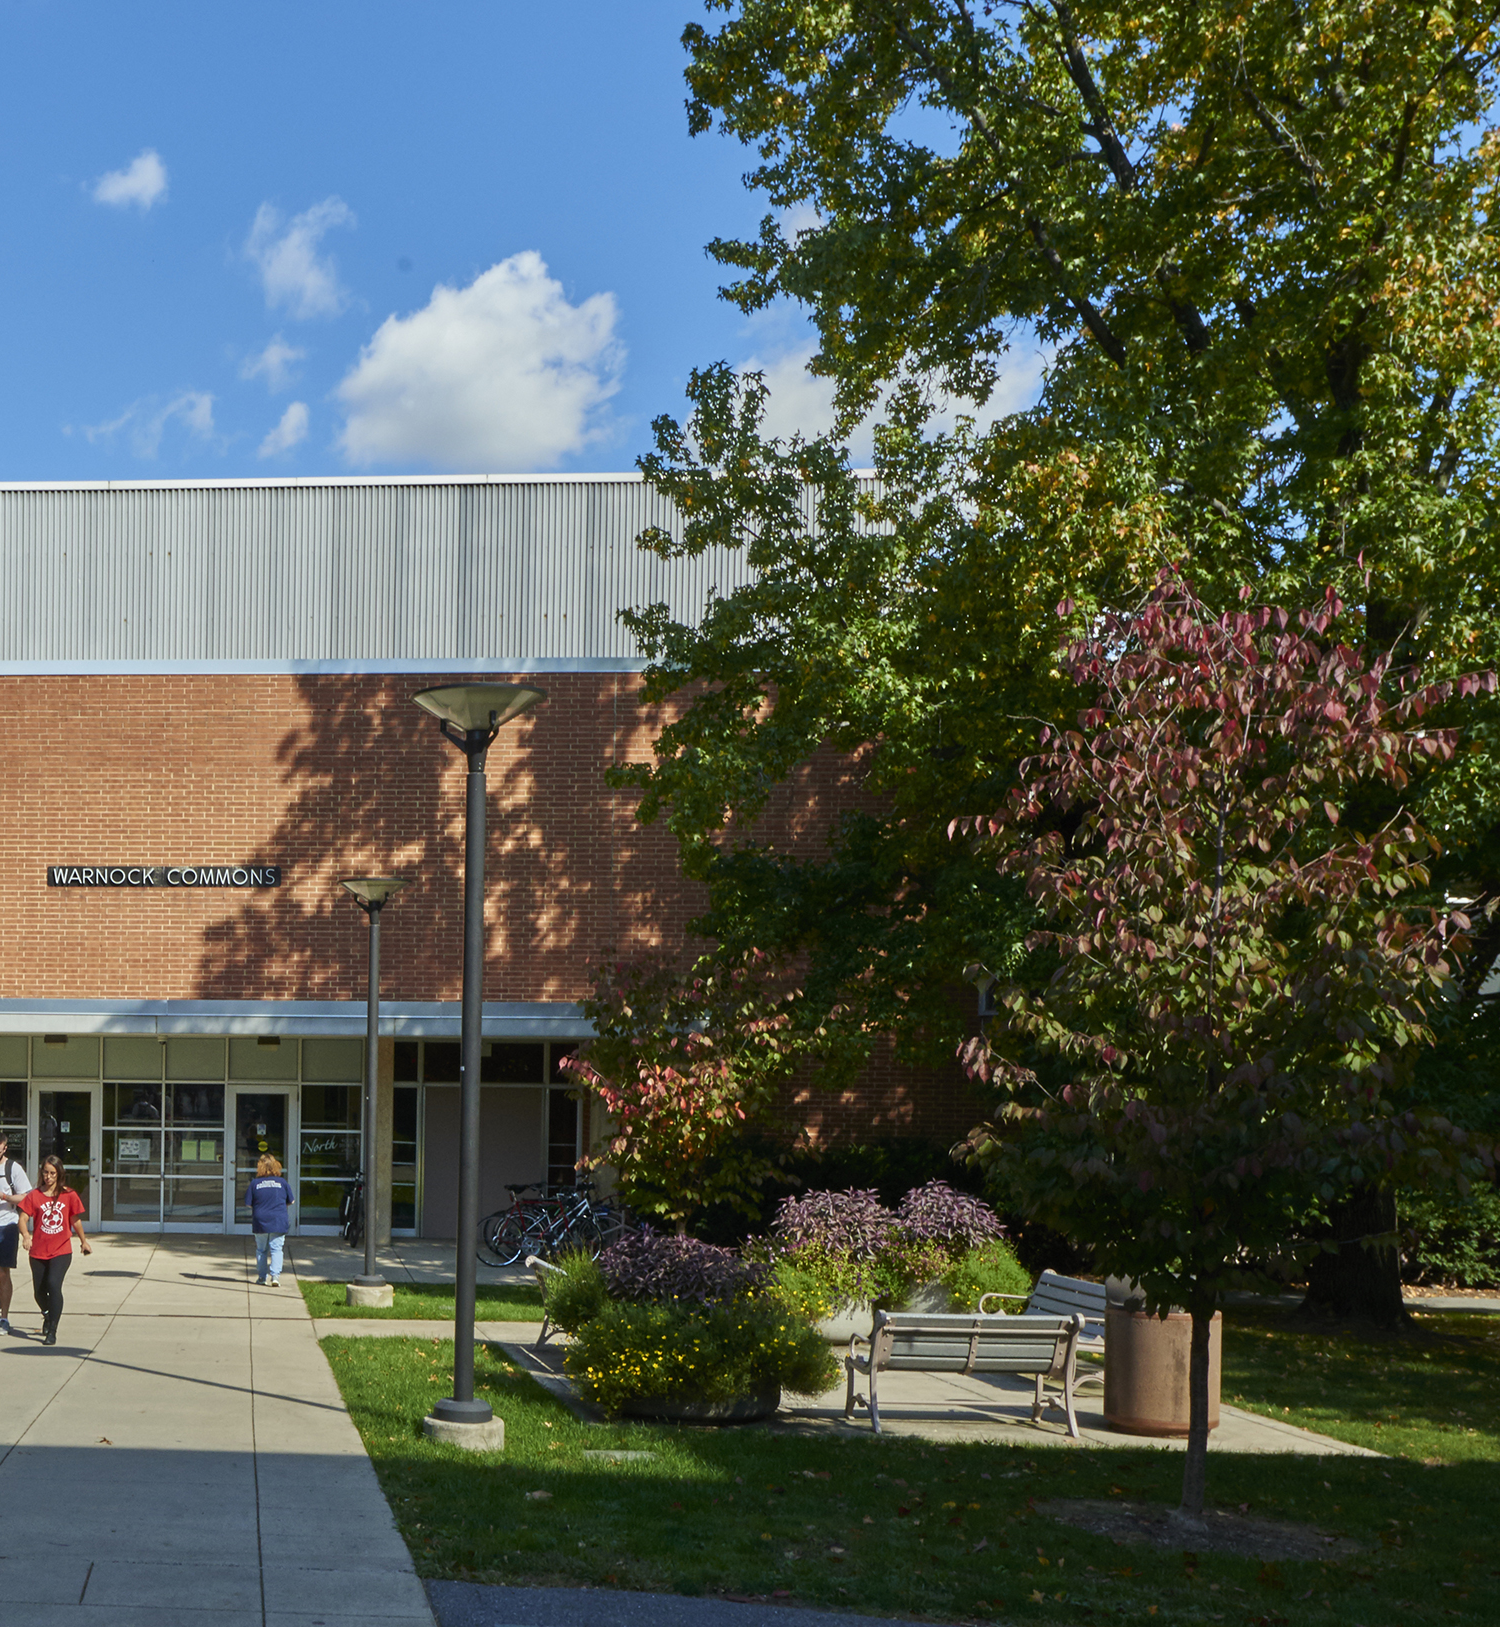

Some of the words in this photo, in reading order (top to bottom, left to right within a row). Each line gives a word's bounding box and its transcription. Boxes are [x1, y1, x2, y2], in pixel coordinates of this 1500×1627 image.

[53, 868, 155, 885] WARNOCK
[167, 868, 276, 885] COMMONS
[302, 1135, 338, 1154] North
